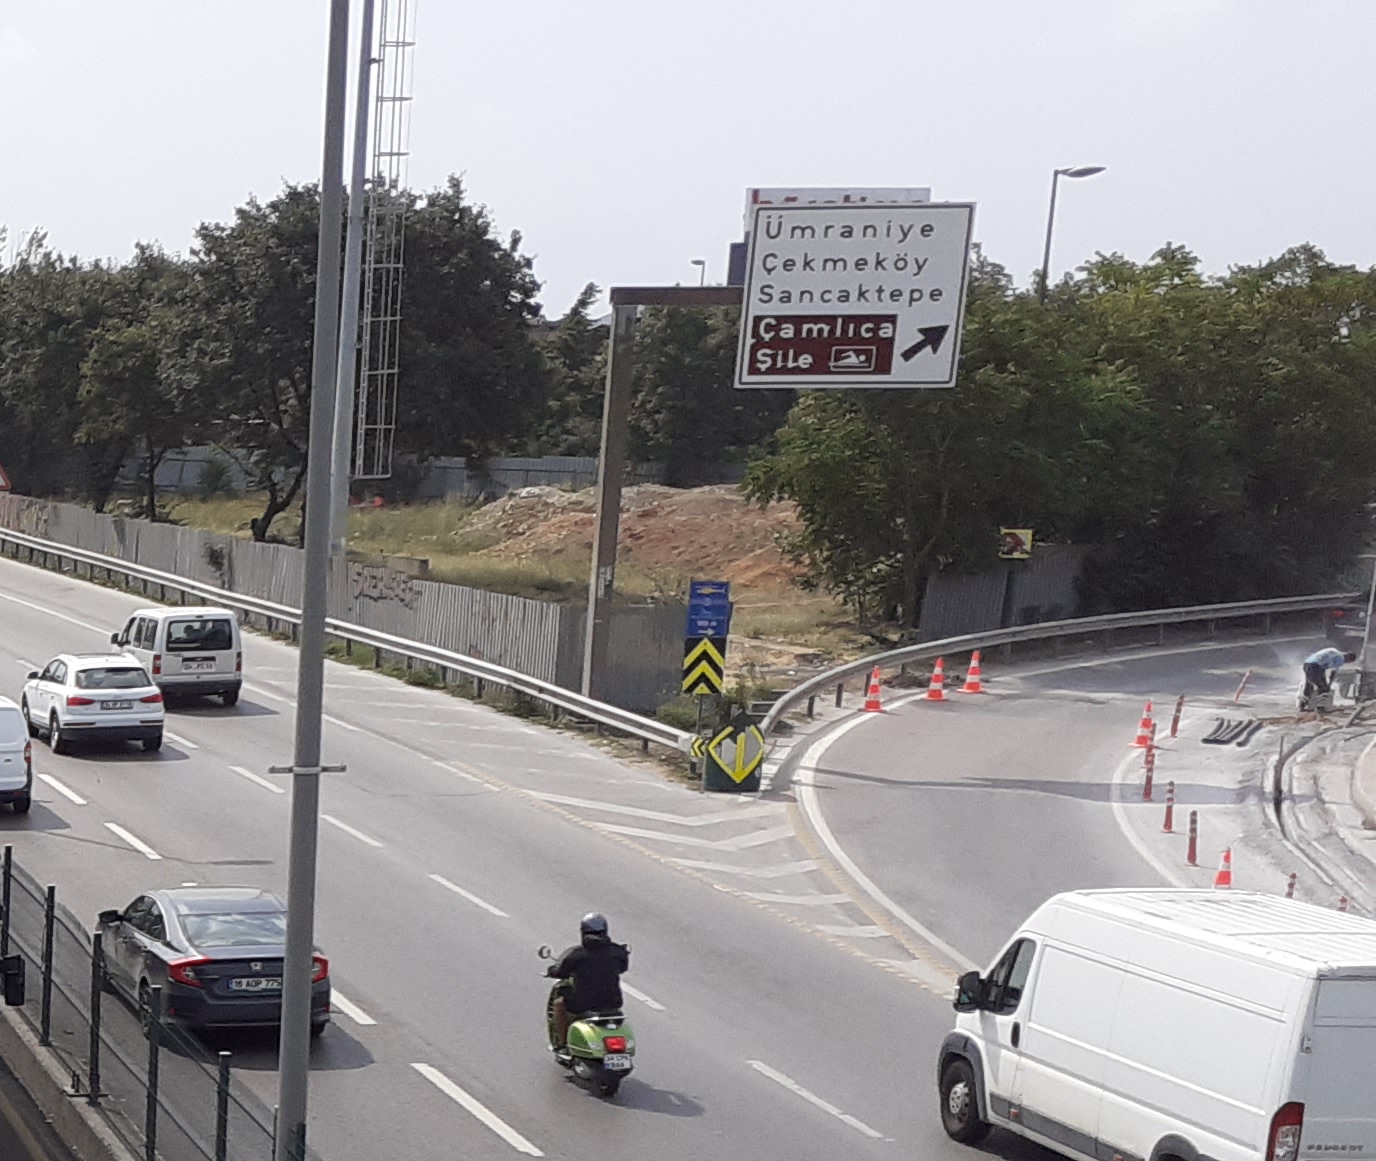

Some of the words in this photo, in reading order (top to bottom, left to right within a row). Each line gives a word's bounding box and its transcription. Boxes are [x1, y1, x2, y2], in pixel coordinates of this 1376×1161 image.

[765, 215, 935, 243] Ümraniye
[762, 252, 929, 276] Çekmeköy
[759, 284, 944, 307] Sancaktepe
[759, 317, 894, 342] Çamlıca
